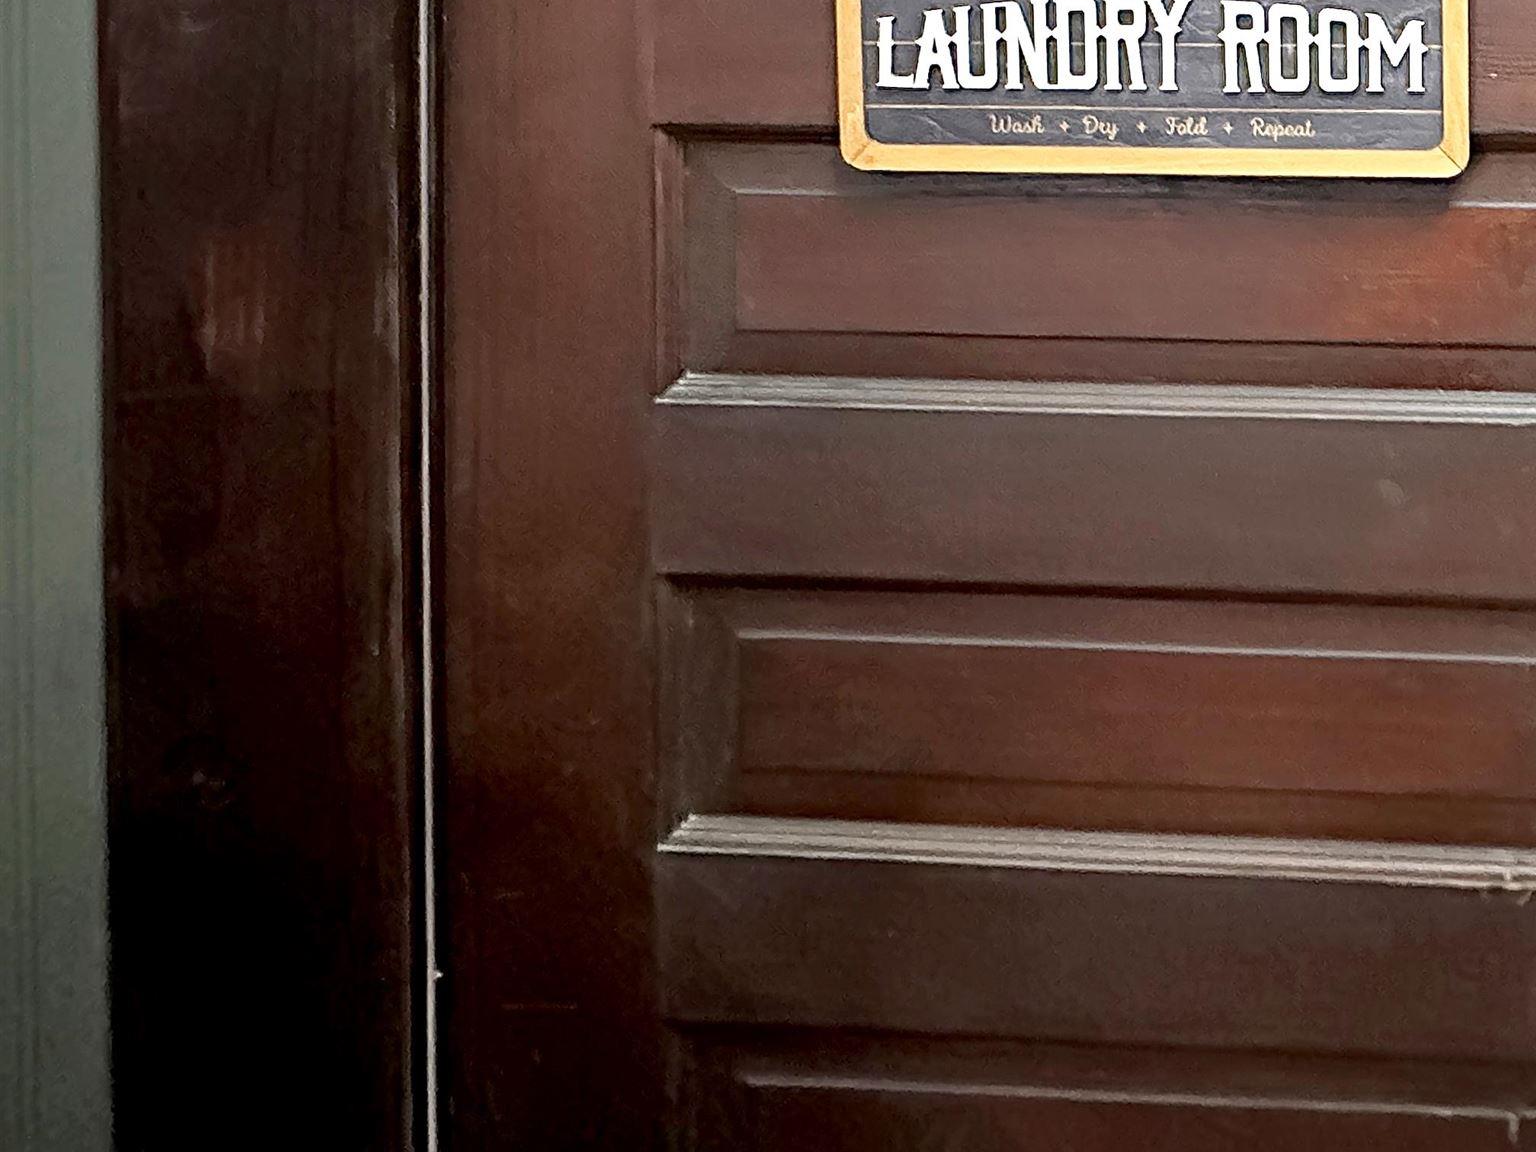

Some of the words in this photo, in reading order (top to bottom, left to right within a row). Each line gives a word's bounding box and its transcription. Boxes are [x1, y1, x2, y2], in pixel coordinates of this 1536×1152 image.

[988, 112, 1045, 134] Wash
[1081, 114, 1119, 141] Dry
[1164, 115, 1209, 136] Fold
[1249, 116, 1317, 142] Repeat
